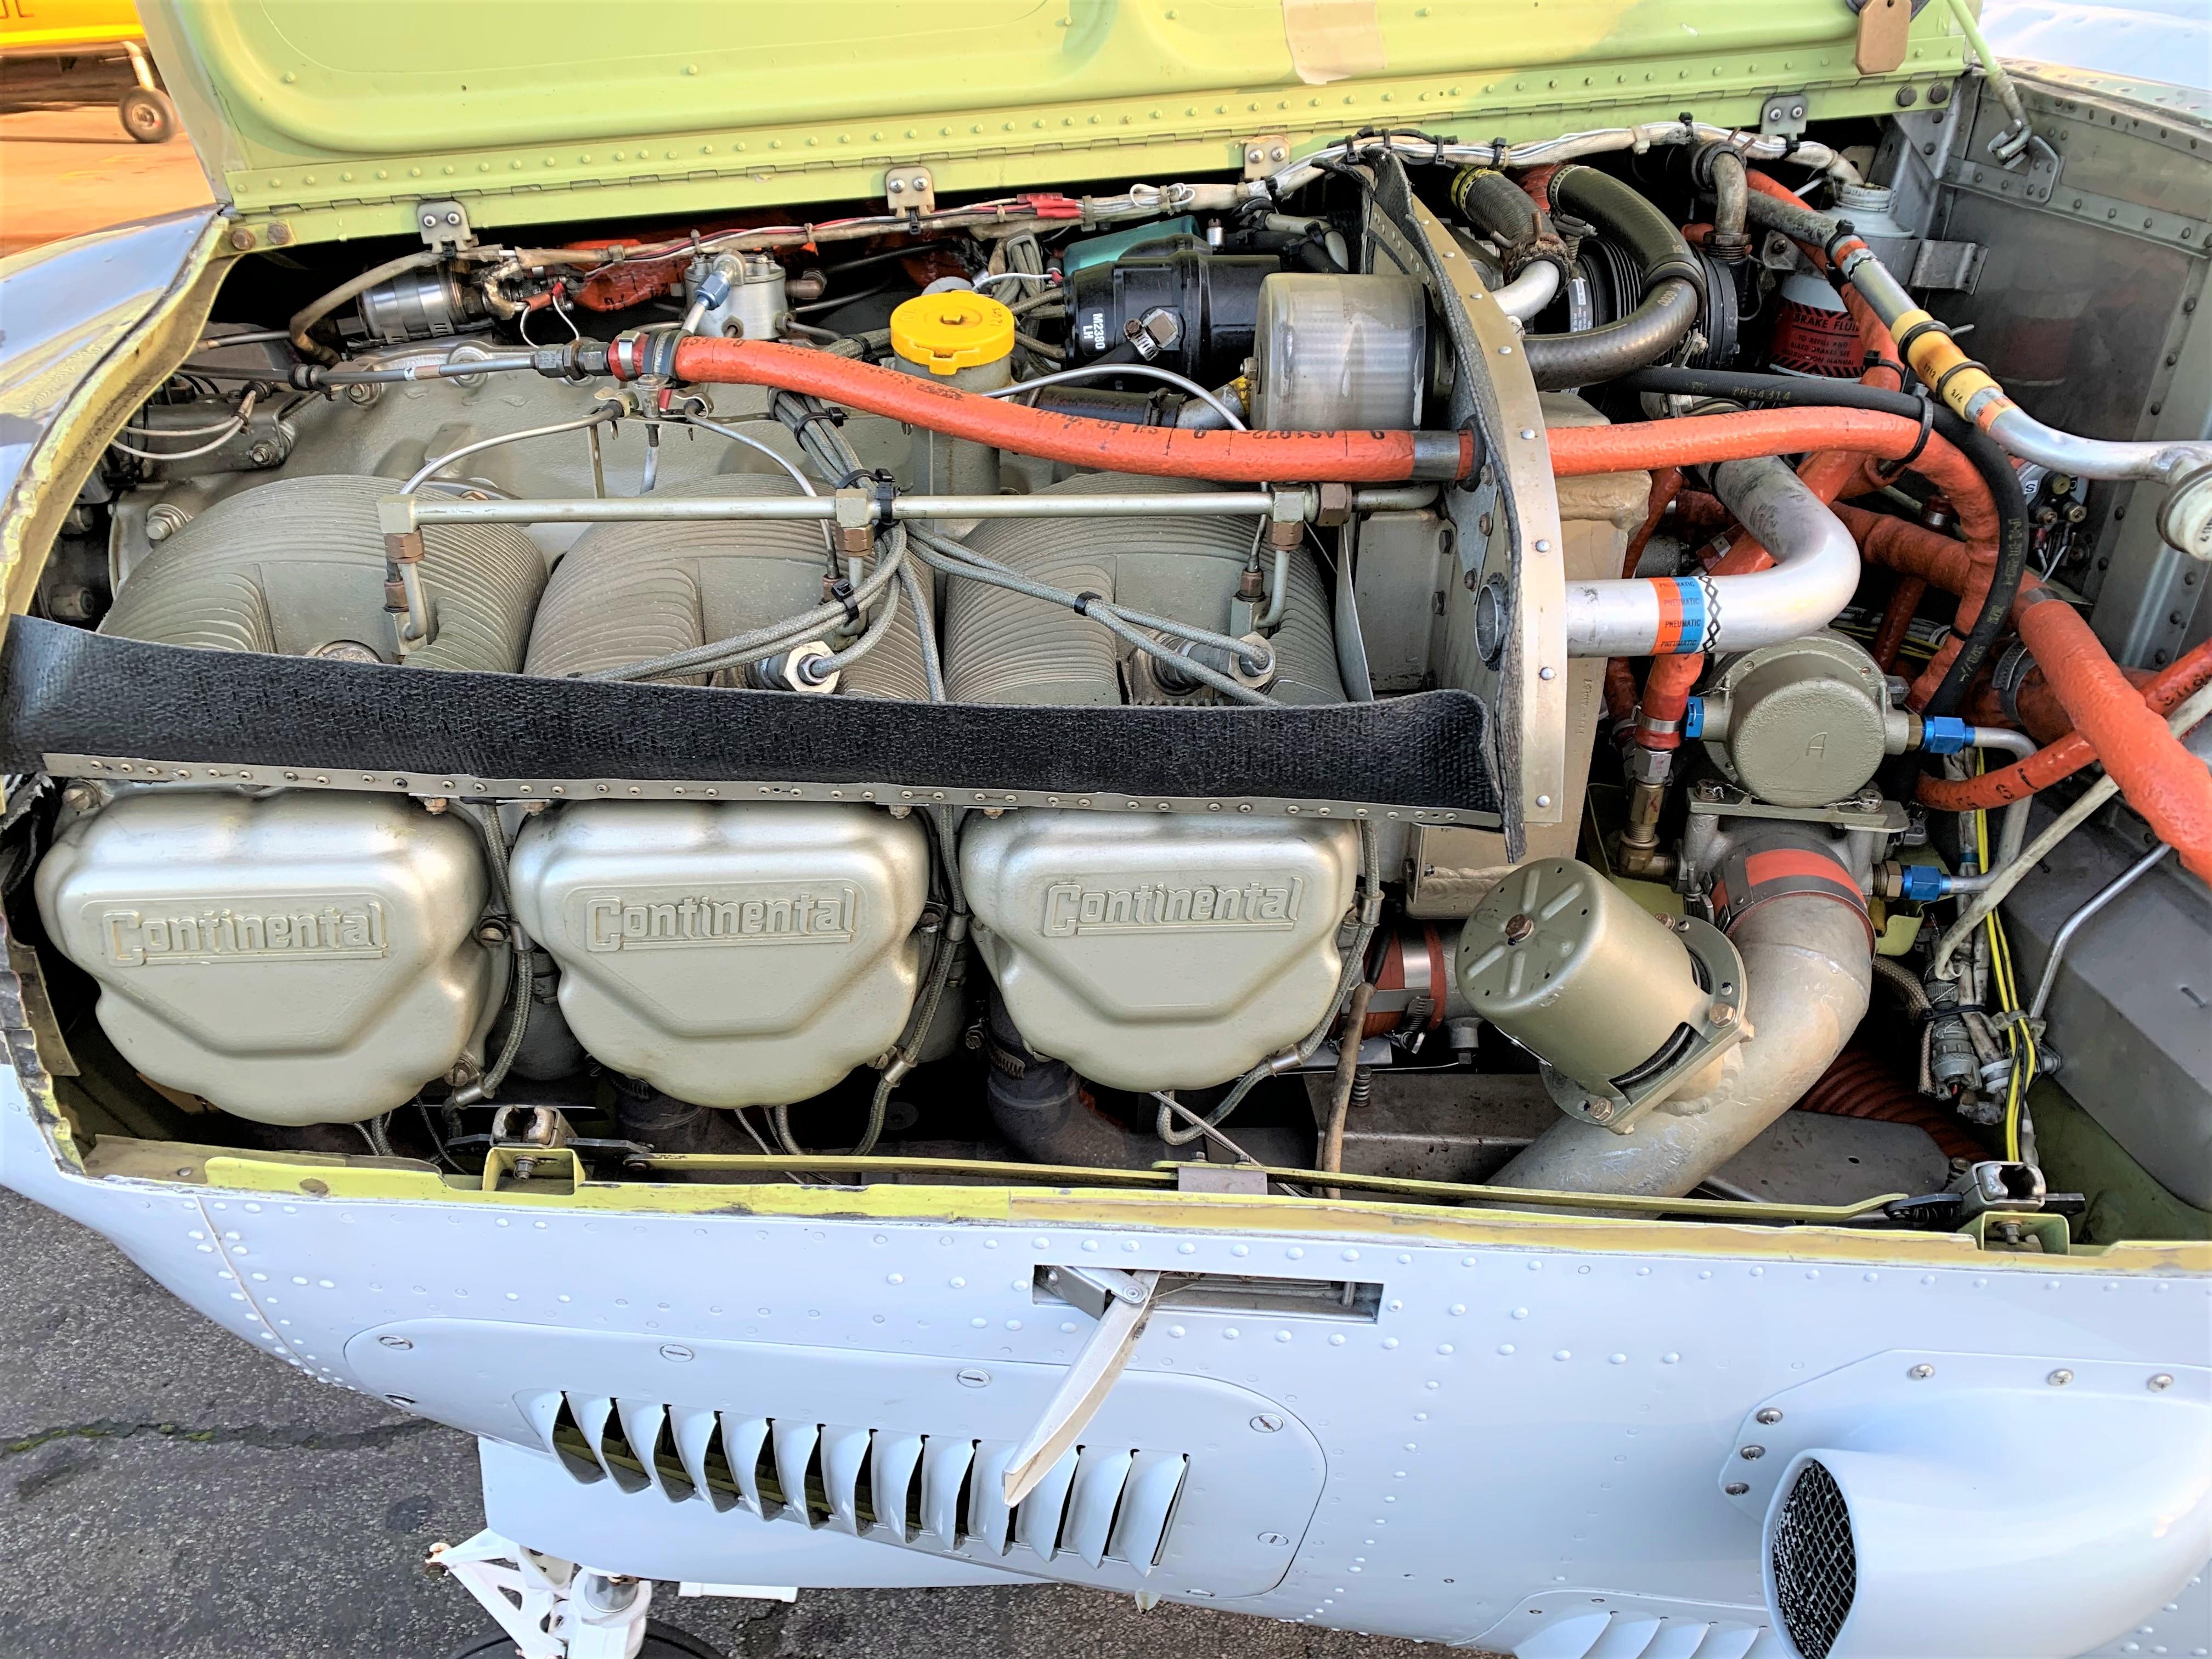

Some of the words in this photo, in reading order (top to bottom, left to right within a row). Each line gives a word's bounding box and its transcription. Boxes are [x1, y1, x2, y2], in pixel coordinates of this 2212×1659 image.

[1793, 313, 1829, 328] BRAKE
[1082, 325, 1094, 339] LH
[1092, 313, 1105, 349] M2380
[1790, 341, 1809, 351] BLEED
[1809, 336, 1830, 346] REFILL
[2025, 483, 2036, 492] S
[1663, 597, 1700, 606] PNEUMATIC
[1664, 618, 1701, 628] PNEUMATIC
[1660, 639, 1698, 647] PNEUMATIC
[1805, 731, 1829, 759] A
[1043, 874, 1304, 937] Continental
[586, 887, 857, 952] Continental
[102, 900, 388, 967] Continental
